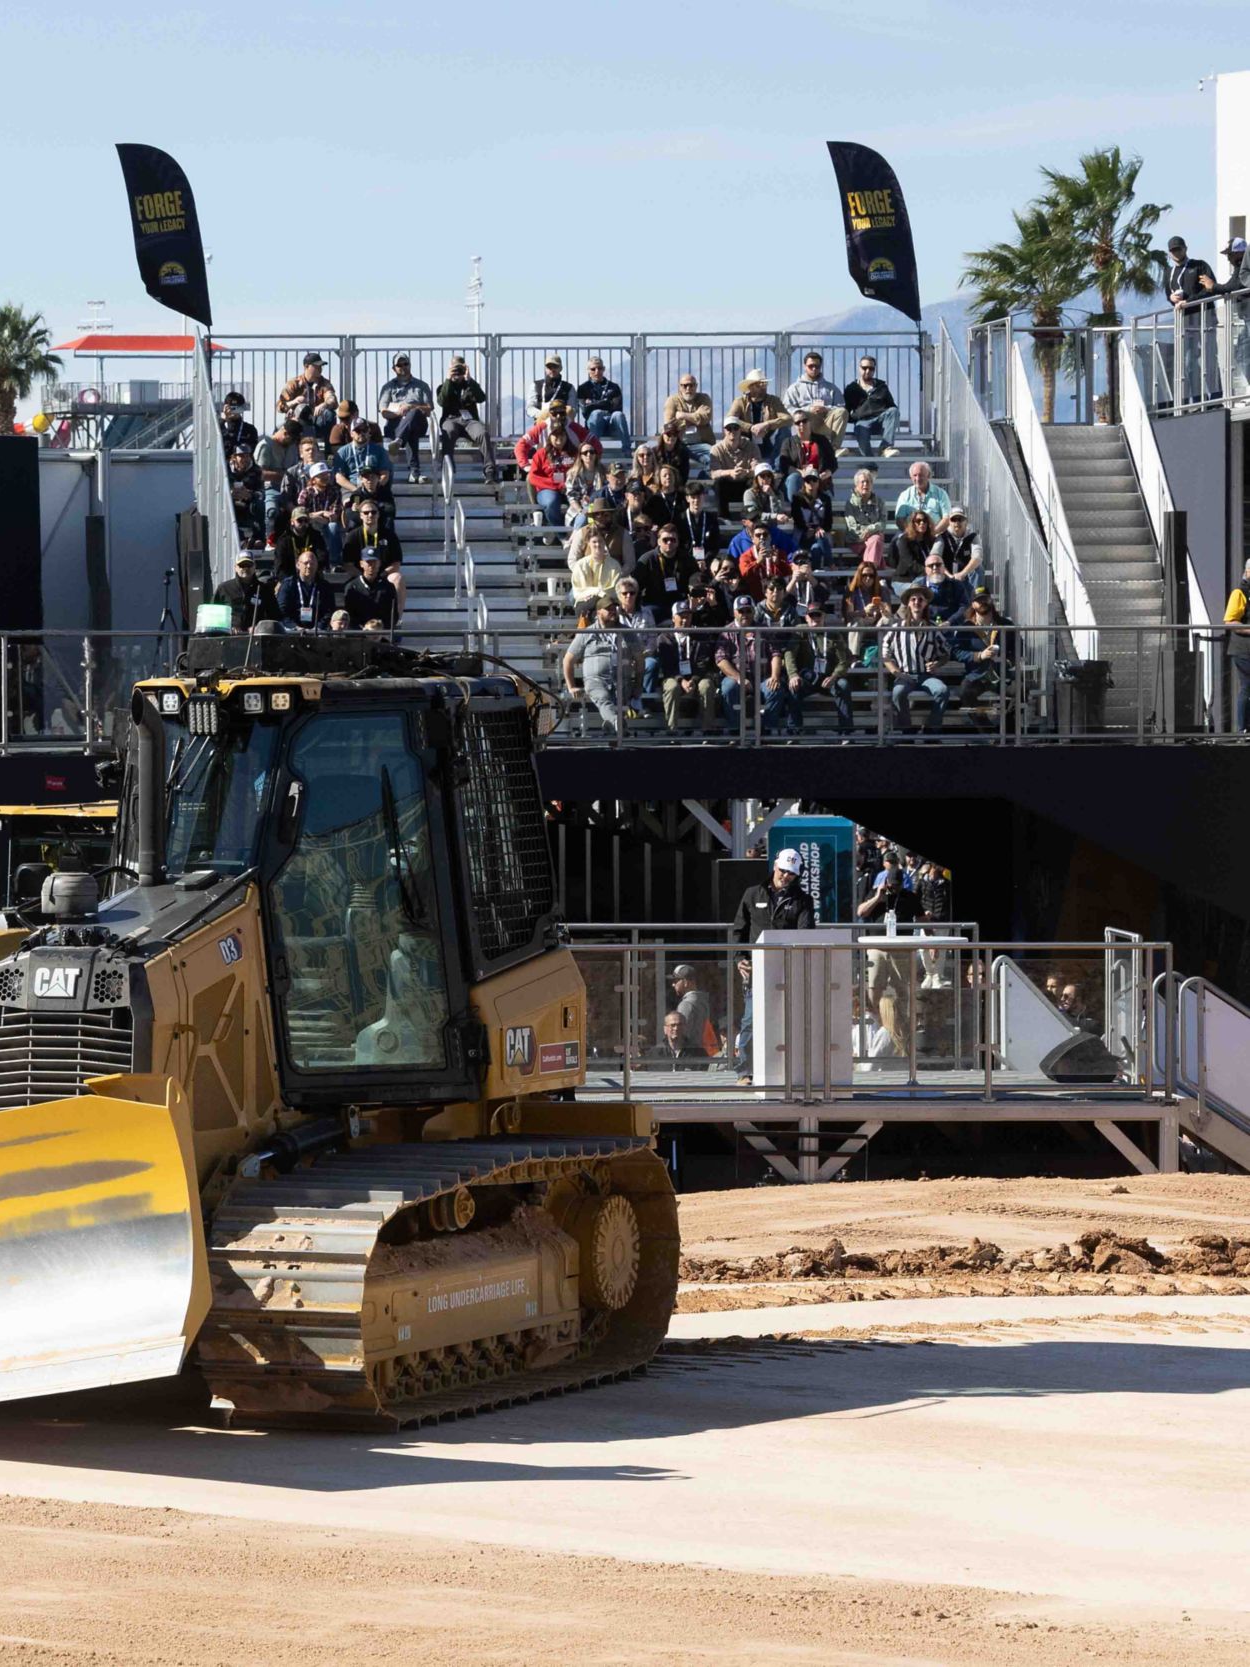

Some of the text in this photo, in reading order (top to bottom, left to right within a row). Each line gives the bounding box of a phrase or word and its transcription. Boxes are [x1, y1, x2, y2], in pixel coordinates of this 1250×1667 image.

[135, 191, 185, 221] FORGE
[847, 189, 895, 217] FORGE
[140, 218, 186, 235] YOUR LEGACY
[852, 215, 896, 231] YOUR LEGACY
[811, 842, 820, 910] WORKSHOP
[220, 937, 238, 964] D3
[34, 967, 80, 998] CAT
[507, 1027, 530, 1065] CAT
[428, 1294, 448, 1313] LONG
[450, 1280, 510, 1309] UNDERCARRIAGE
[511, 1278, 525, 1296] LIFE
